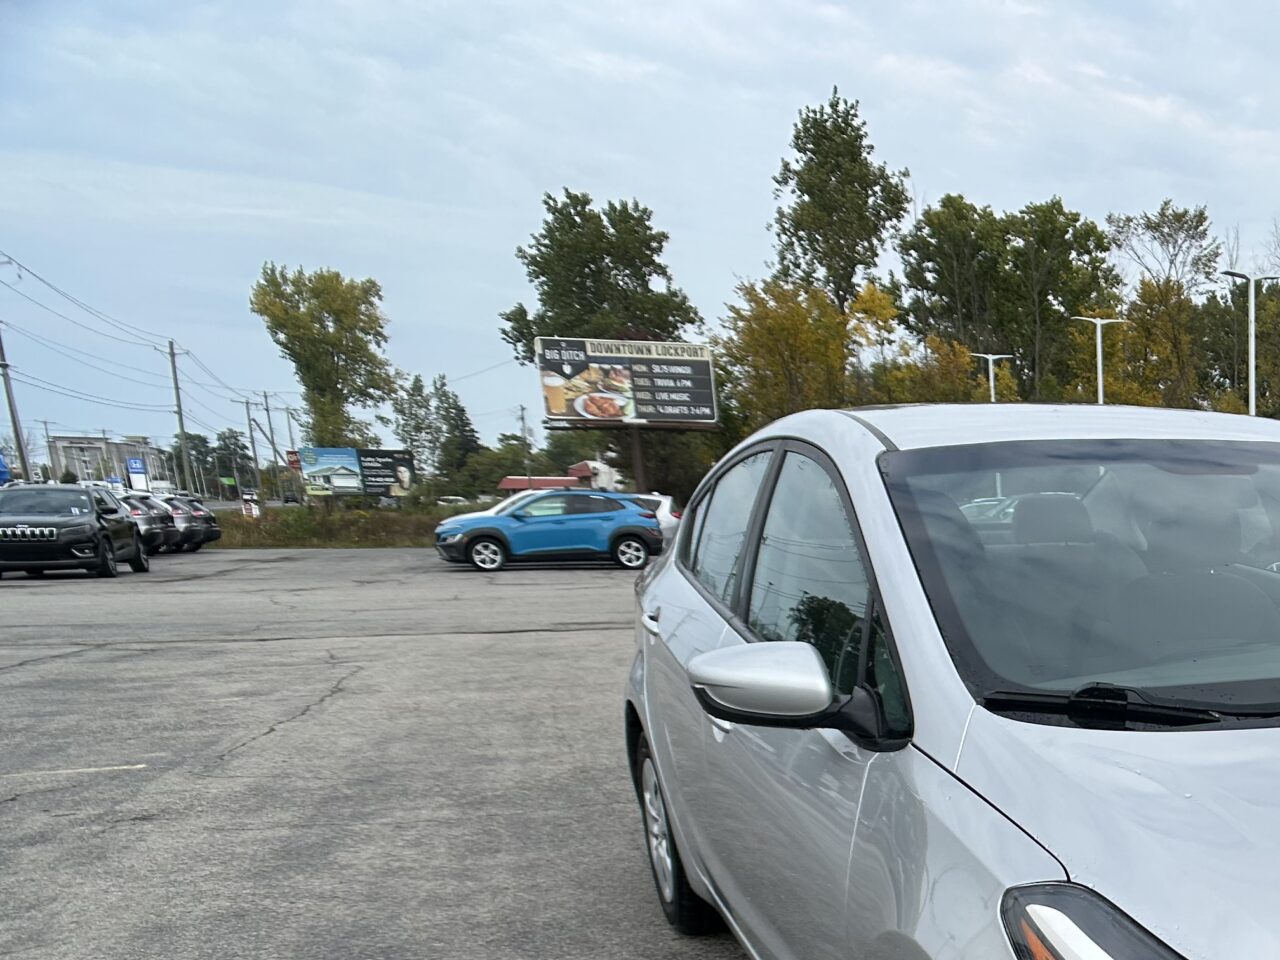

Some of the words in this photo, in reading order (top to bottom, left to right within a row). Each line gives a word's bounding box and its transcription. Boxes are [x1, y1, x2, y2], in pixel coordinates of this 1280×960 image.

[544, 349, 560, 360] BIG
[560, 350, 586, 361] DITCH
[589, 342, 653, 356] DOWNTOWN
[655, 345, 705, 358] LOCKPORT
[669, 392, 691, 402] MUSIC
